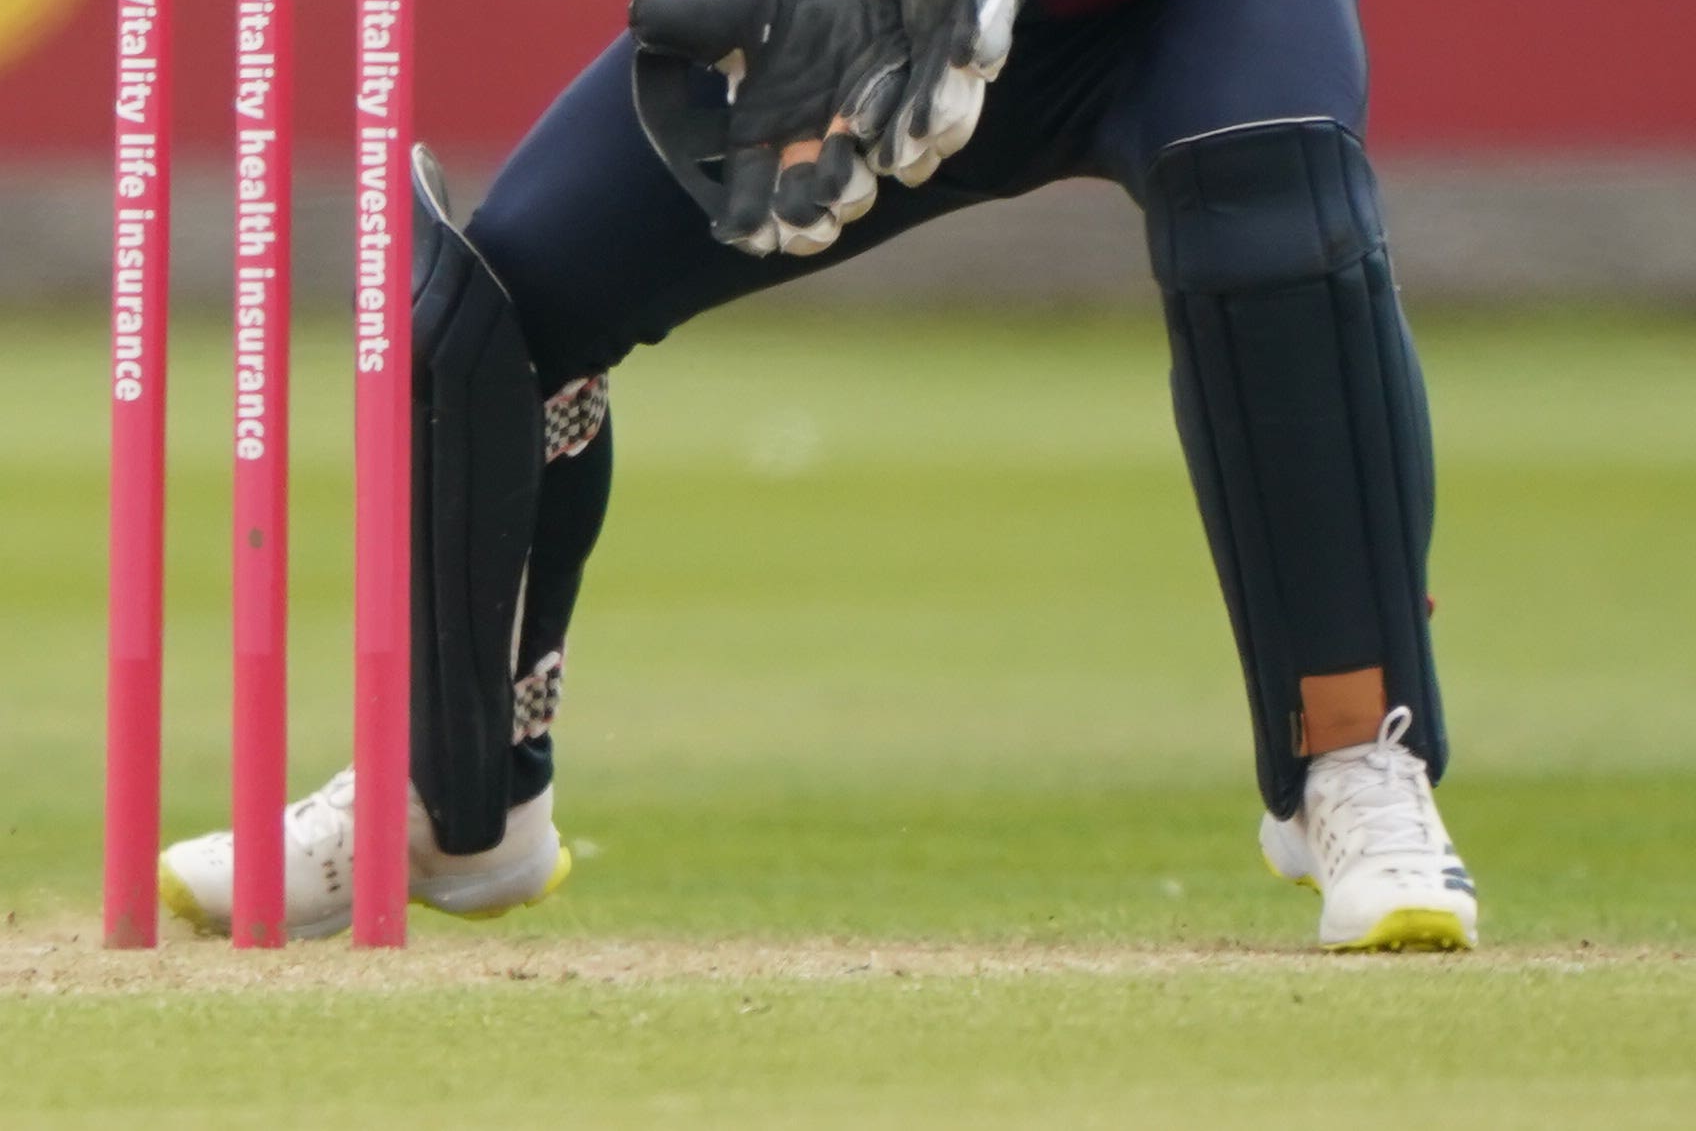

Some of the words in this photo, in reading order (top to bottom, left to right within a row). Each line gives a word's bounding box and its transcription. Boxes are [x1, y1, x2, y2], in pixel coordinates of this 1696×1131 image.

[118, 133, 157, 198] life
[239, 129, 277, 256] health
[359, 127, 398, 372] investments
[115, 209, 155, 401] insurance
[237, 267, 276, 460] insurance
